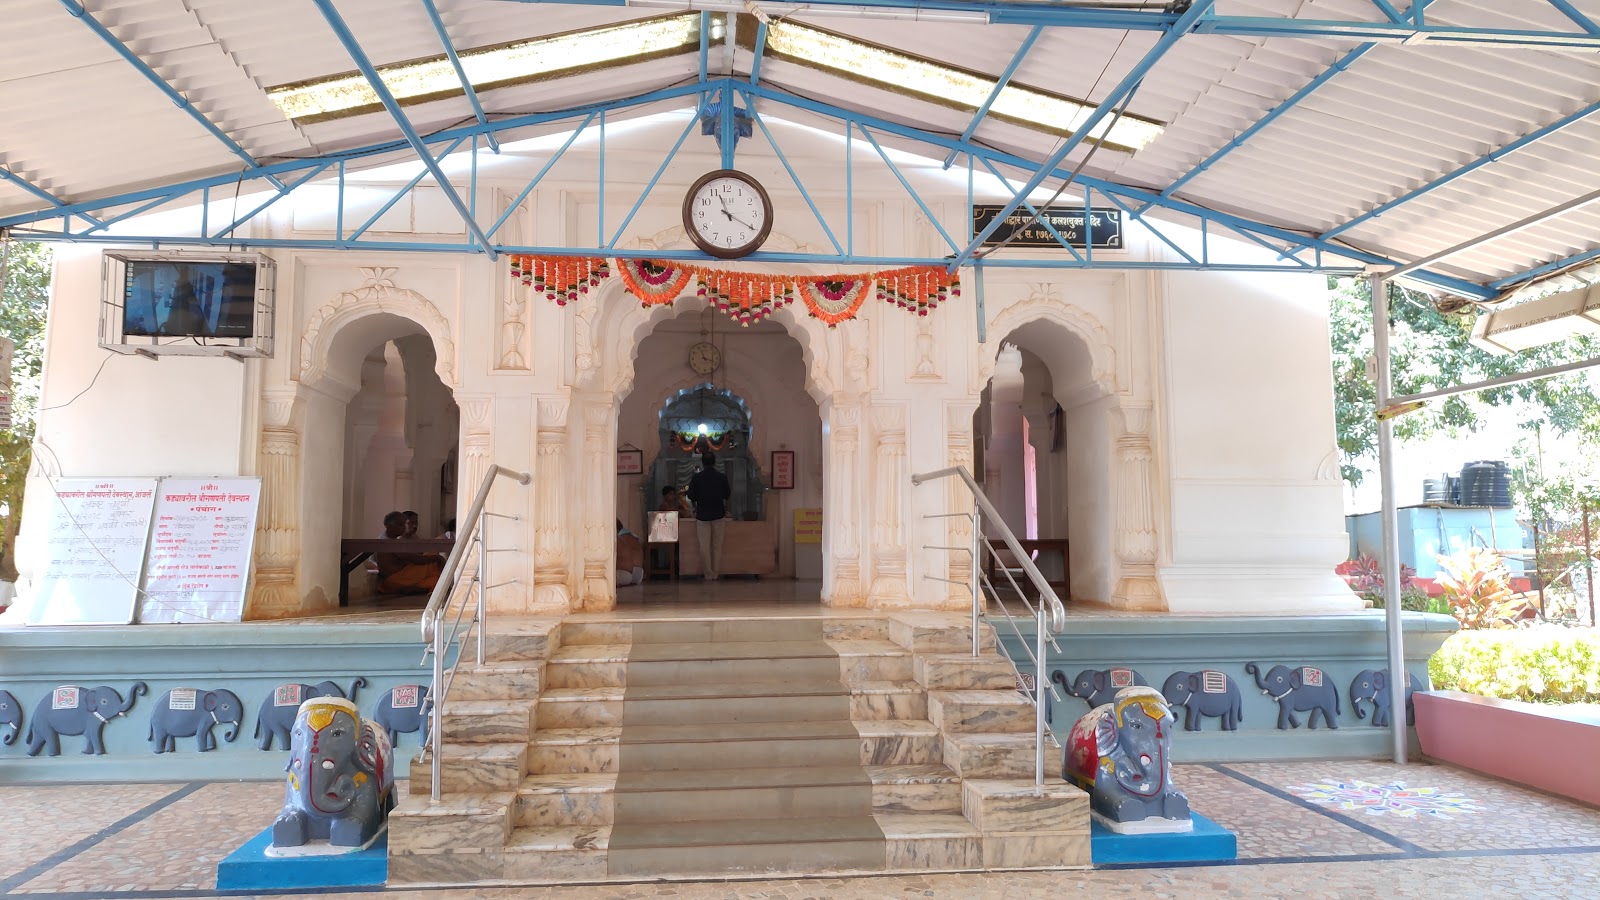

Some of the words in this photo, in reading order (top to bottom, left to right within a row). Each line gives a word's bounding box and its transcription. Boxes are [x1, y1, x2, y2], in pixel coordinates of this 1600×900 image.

[710, 188, 718, 196] 11
[723, 184, 732, 192] 12
[702, 198, 711, 206] 10
